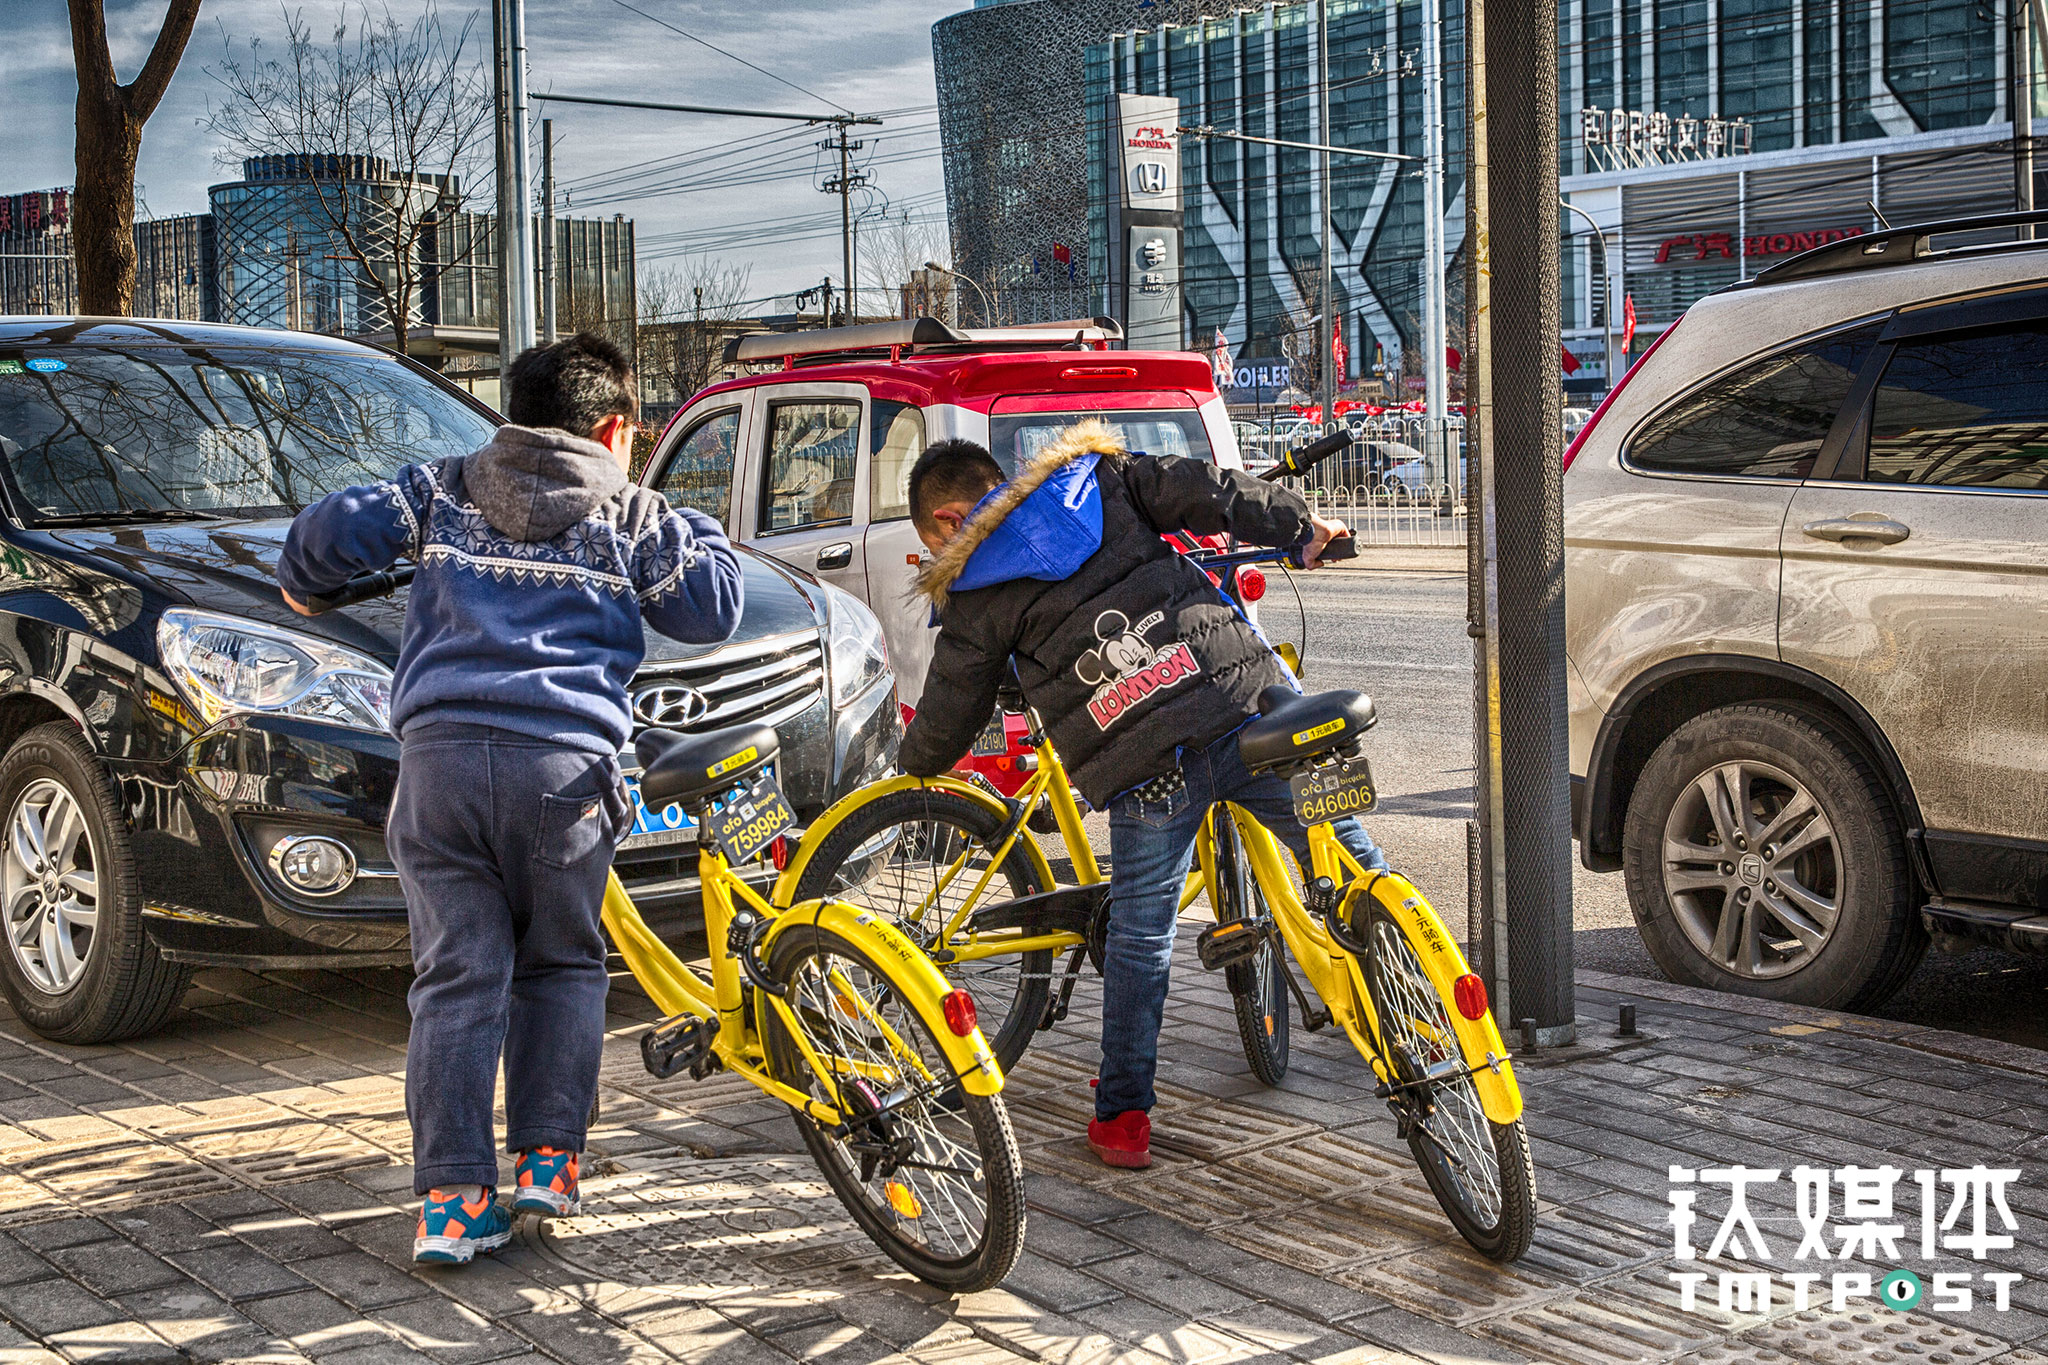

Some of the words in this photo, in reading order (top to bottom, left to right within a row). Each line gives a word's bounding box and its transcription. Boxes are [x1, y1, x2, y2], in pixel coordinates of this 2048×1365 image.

[1128, 138, 1172, 149] HONDA
[1135, 126, 1165, 138] 广汽
[1654, 232, 1733, 263] 广汽
[1136, 612, 1161, 634] LIVELY
[1088, 643, 1199, 730] LONDON
[1310, 721, 1340, 738] 1元骑车
[1301, 783, 1322, 797] ofo
[1340, 773, 1366, 785] bicycle
[722, 816, 742, 834] ofo
[754, 791, 776, 810] bicycle
[1303, 785, 1371, 819] 646006
[728, 803, 789, 856] 759984
[1411, 907, 1446, 954] 1元骑车
